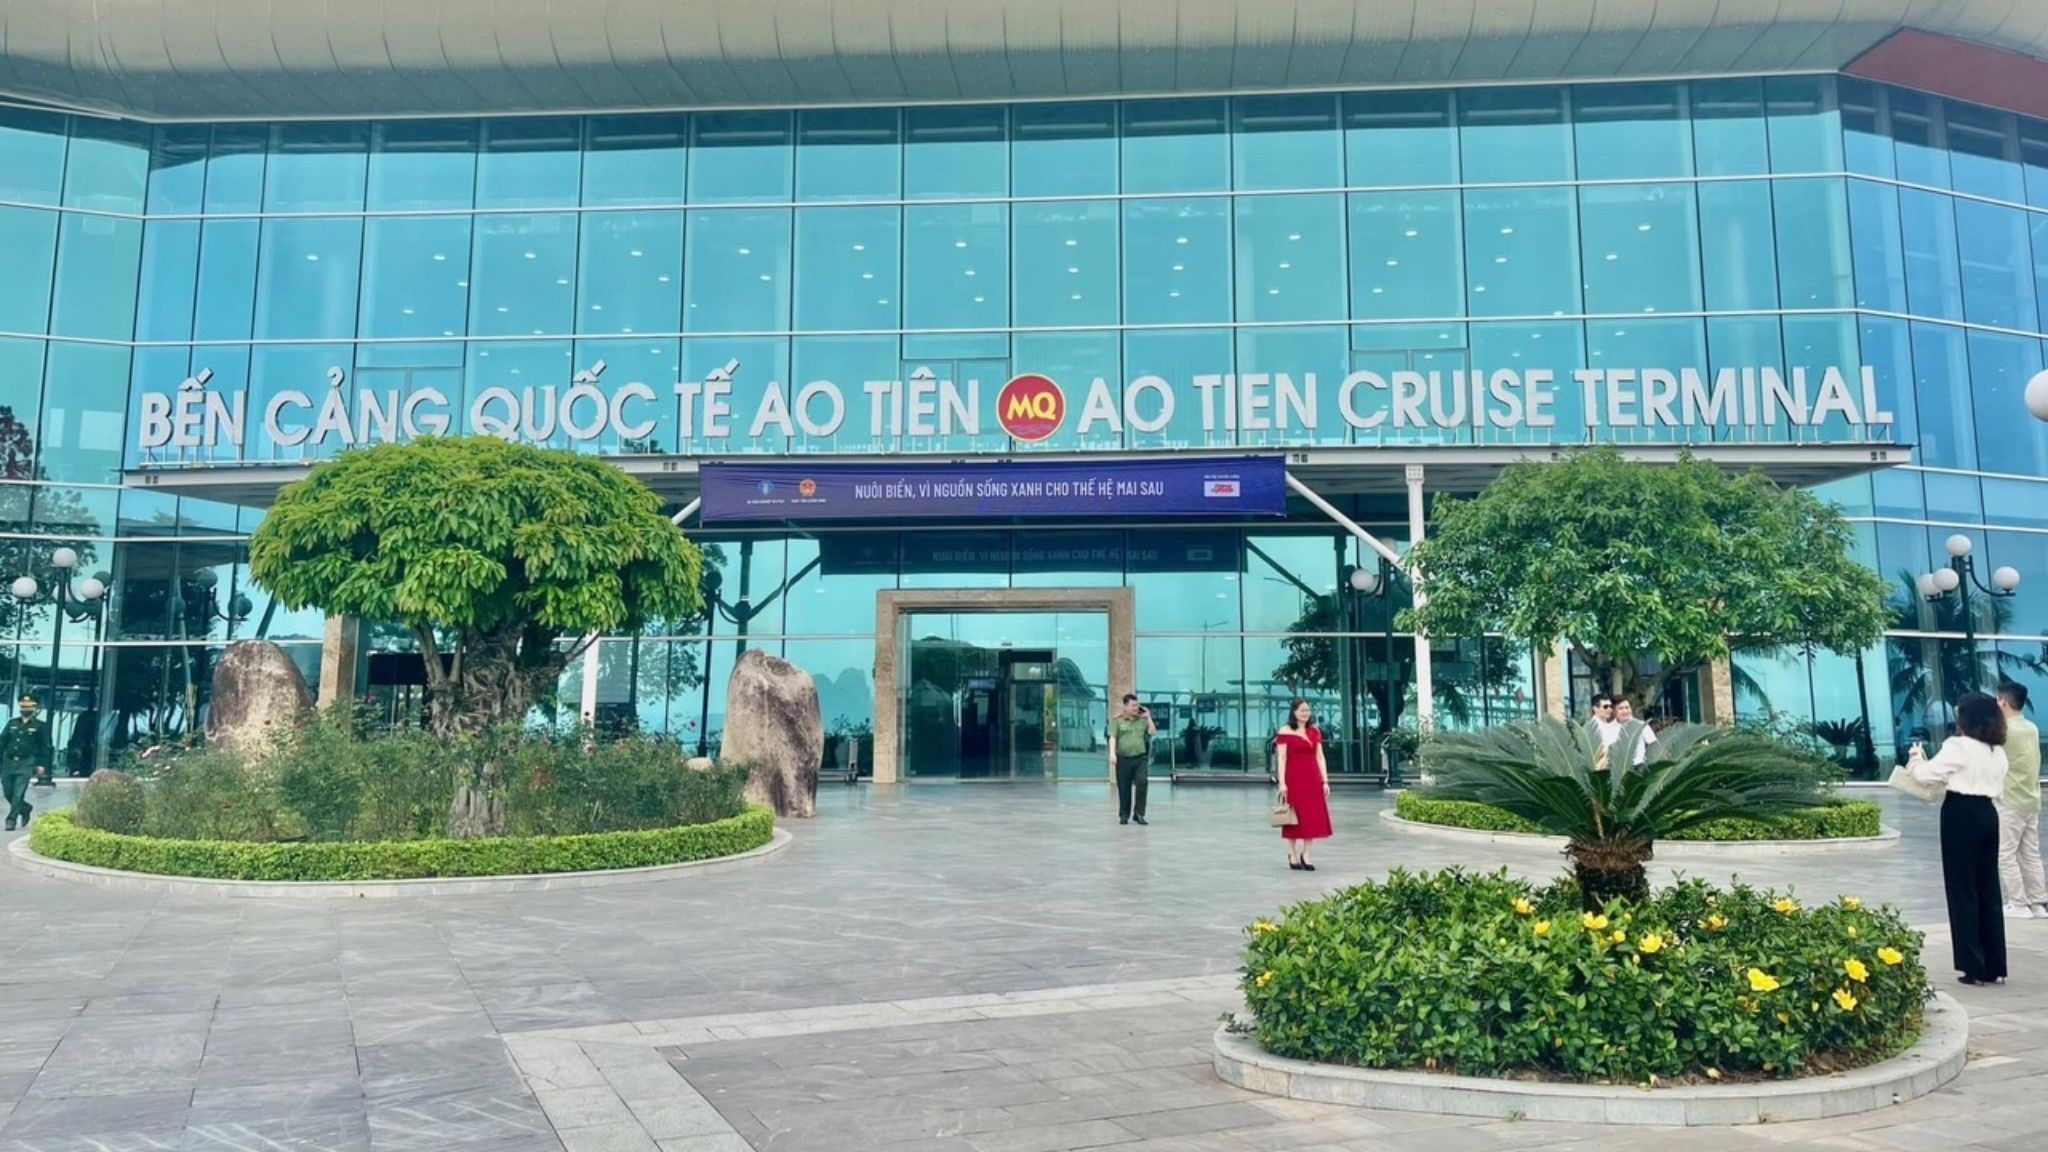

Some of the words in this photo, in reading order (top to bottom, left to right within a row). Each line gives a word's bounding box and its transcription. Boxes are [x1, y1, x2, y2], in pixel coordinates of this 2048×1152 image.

[139, 367, 246, 448] BẾN
[265, 366, 452, 445] CẢNG
[470, 359, 659, 442] QUỐC
[674, 357, 741, 438] TẾ
[748, 380, 846, 438] AO
[864, 366, 979, 437] TIÊN
[1006, 391, 1057, 421] MQ
[1077, 375, 1175, 434] AO
[1192, 371, 1318, 431] TIEN
[1338, 368, 1556, 431] CRUISE
[1574, 365, 1895, 429] TERMINAL
[855, 481, 883, 499] NUÔI
[919, 480, 931, 498] VÌ
[976, 477, 1008, 498] SỐNG
[1010, 481, 1043, 497] XANH
[1045, 481, 1070, 497] CHO
[1072, 477, 1096, 497] THẾ
[1098, 478, 1114, 500] HỆ
[1116, 481, 1137, 496] MAI
[1140, 481, 1164, 496] SAU
